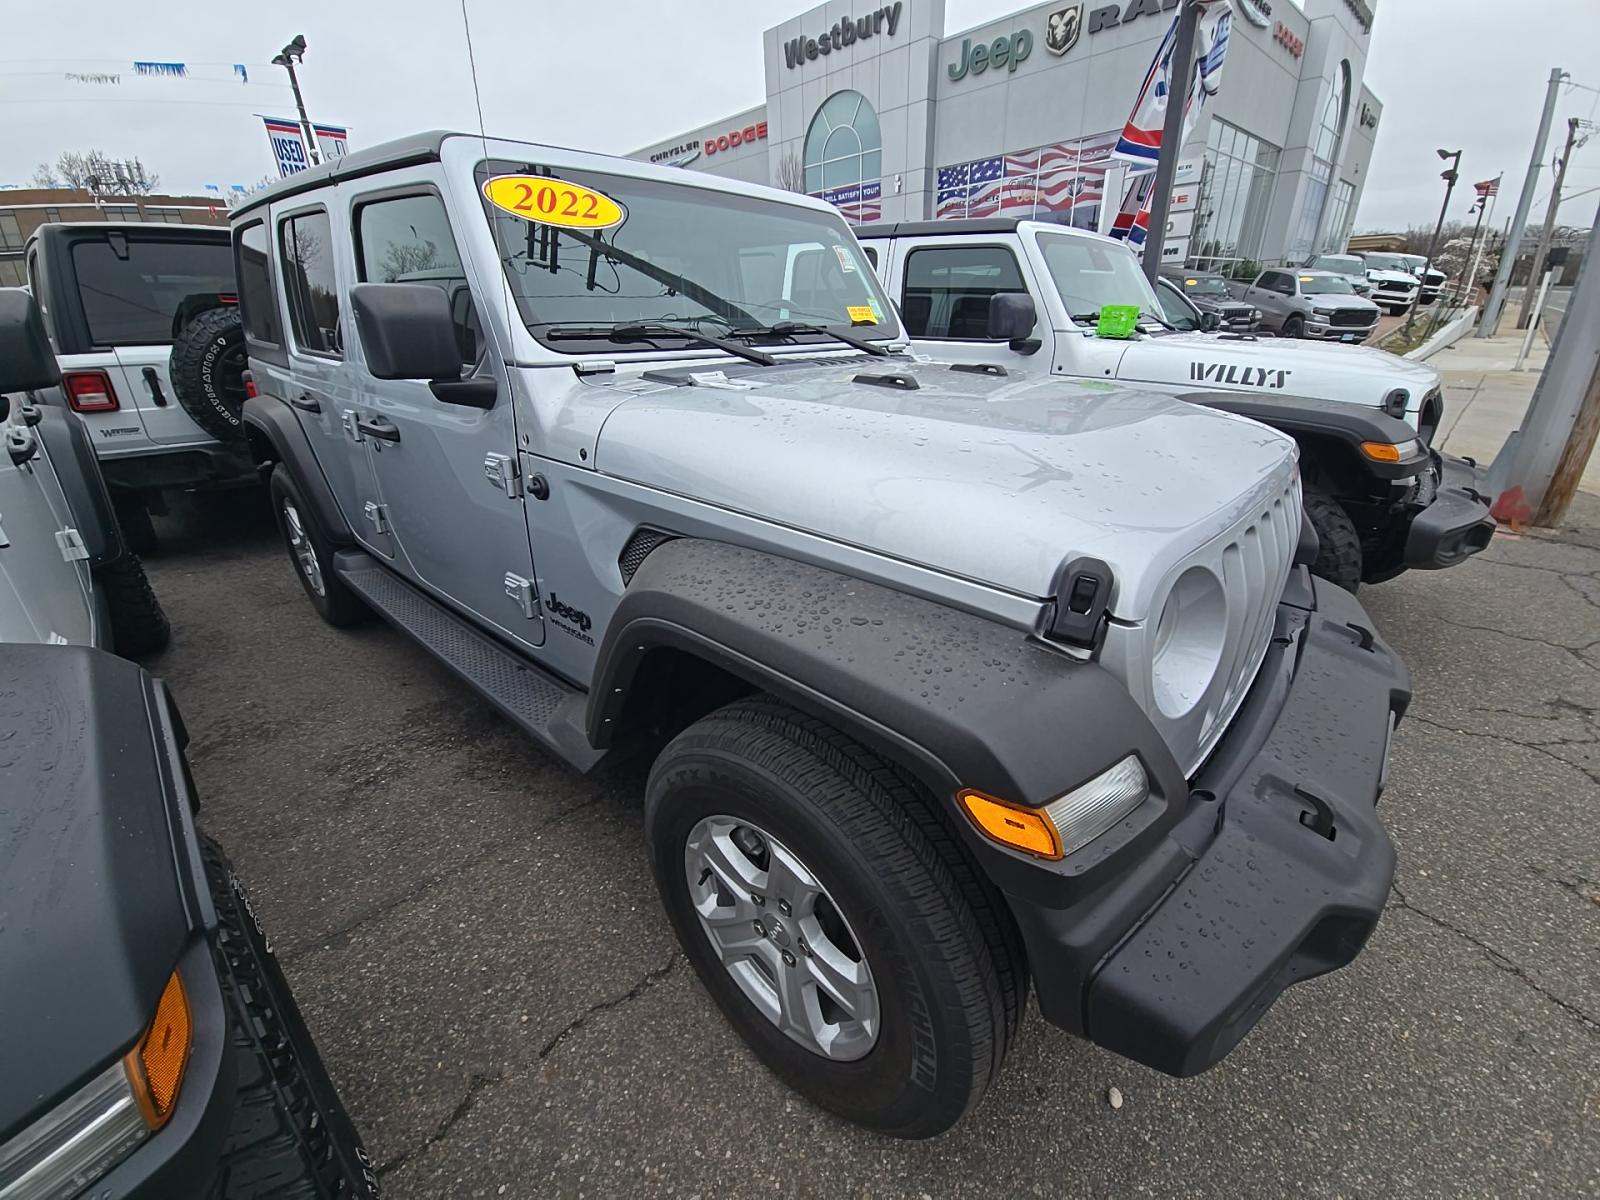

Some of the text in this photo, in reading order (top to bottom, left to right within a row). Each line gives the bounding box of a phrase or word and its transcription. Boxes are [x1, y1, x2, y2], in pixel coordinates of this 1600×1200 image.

[1088, 0, 1179, 34] RA
[784, 1, 902, 70] Westbury
[948, 28, 1033, 81] Jeep
[273, 137, 305, 163] USED
[650, 140, 700, 163] CHRYSLER
[704, 120, 768, 155] DODGE
[281, 162, 308, 178] CA
[513, 183, 599, 219] 2022
[838, 190, 860, 201] SATISFY
[545, 592, 592, 632] Jeep
